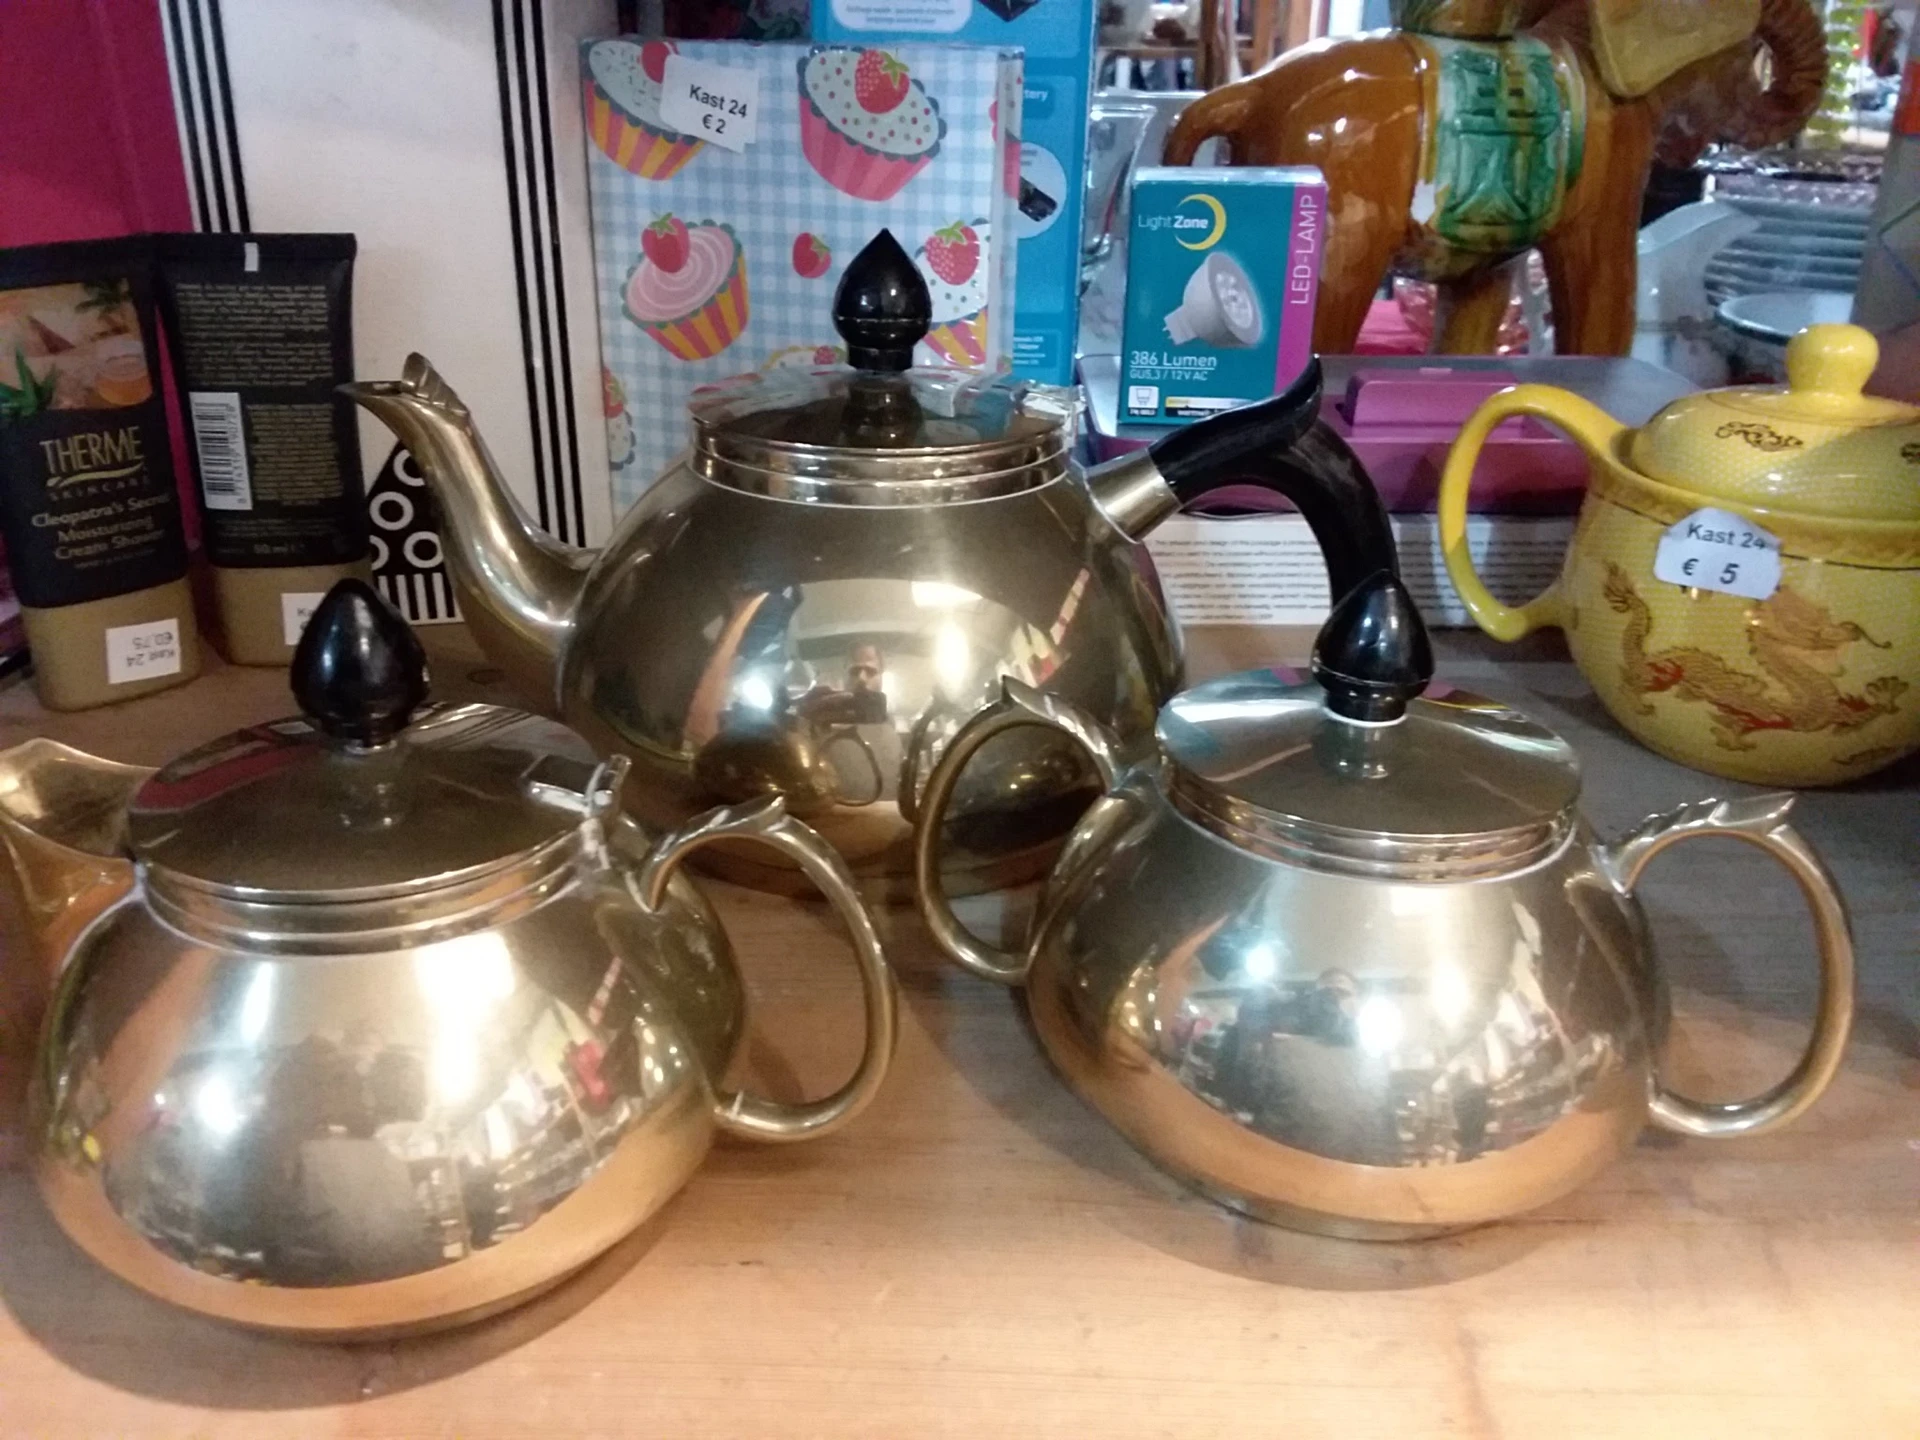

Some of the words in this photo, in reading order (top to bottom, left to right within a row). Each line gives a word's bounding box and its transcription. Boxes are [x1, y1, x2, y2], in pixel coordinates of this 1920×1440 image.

[689, 84, 725, 111] Kast
[728, 99, 747, 118] 24
[702, 113, 713, 130] €
[715, 118, 726, 134] 2
[1290, 194, 1318, 304] LED-LAMP
[1130, 351, 1158, 366] 386
[1163, 351, 1217, 368] Lumen
[39, 425, 145, 474] THERME
[1687, 523, 1736, 546] Kast
[1740, 532, 1767, 550] 24
[1682, 558, 1699, 576] €
[1719, 563, 1740, 584] 5
